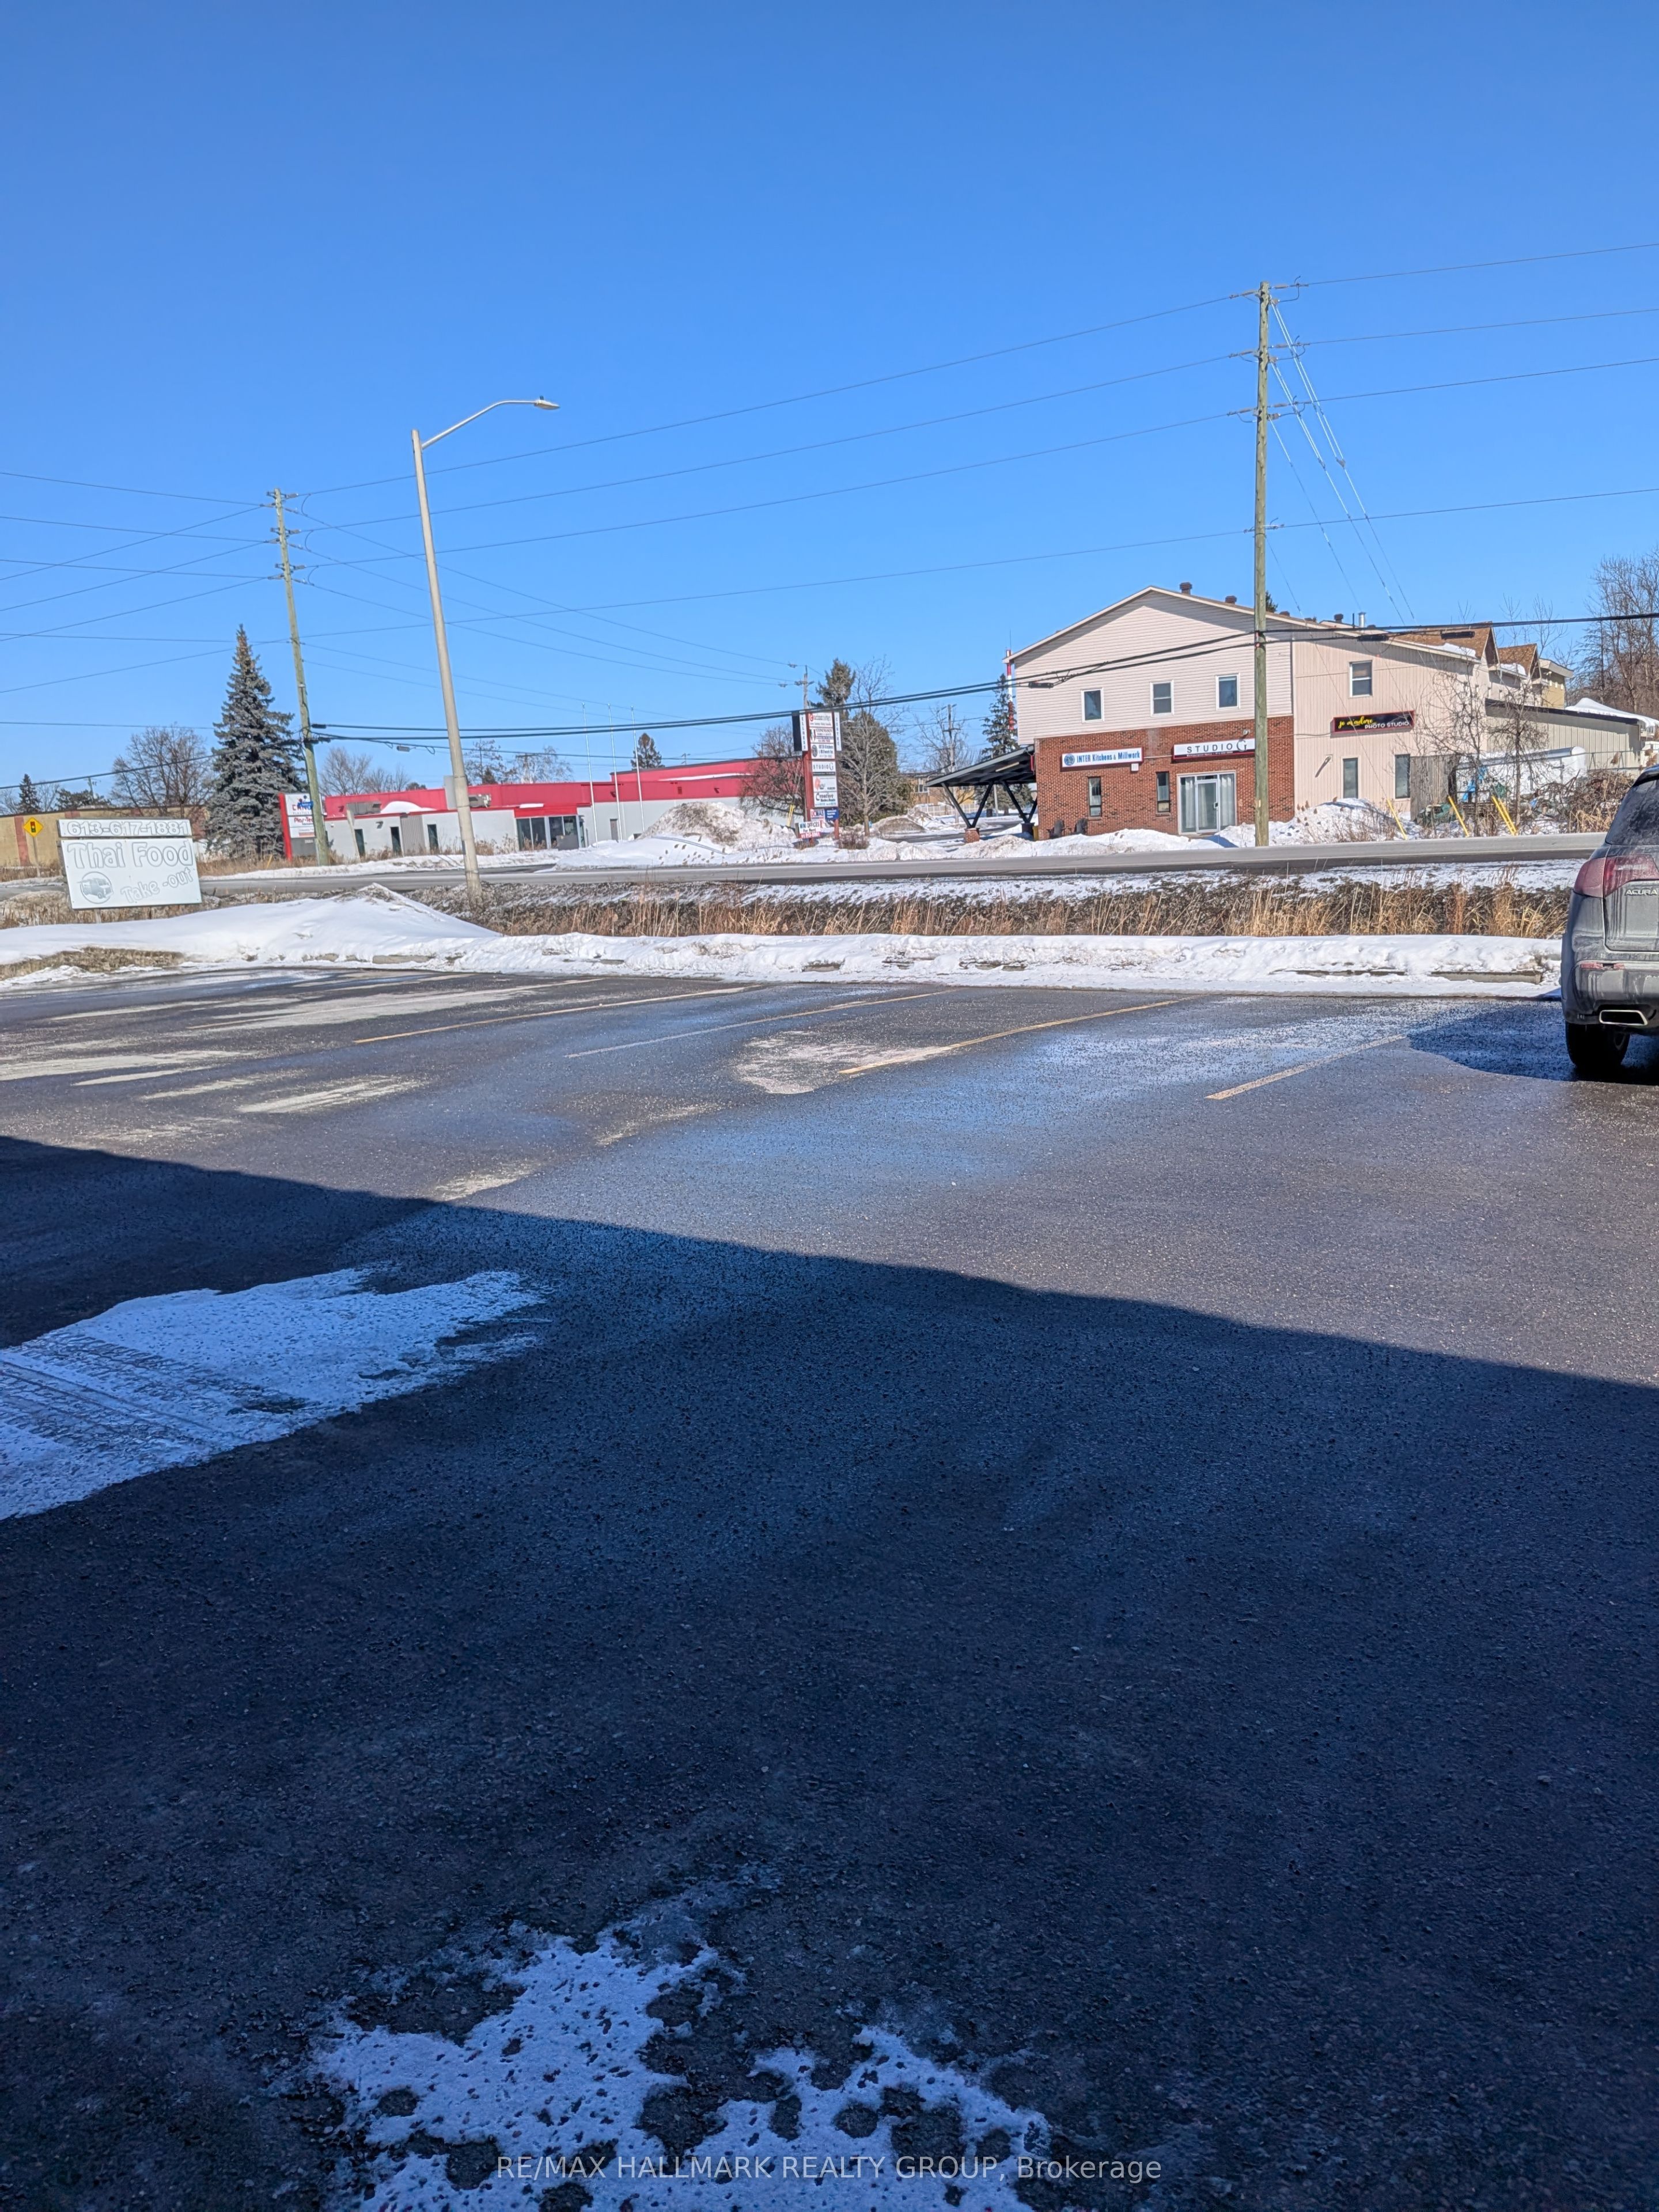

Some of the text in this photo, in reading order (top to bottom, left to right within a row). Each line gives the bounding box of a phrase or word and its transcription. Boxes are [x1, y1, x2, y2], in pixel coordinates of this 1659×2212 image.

[1077, 754, 1091, 763] INTER
[1092, 753, 1112, 762] Kitchens
[1118, 751, 1140, 760] Millwork
[67, 821, 190, 836] 613-617-1881
[67, 840, 194, 869] Thai Food
[120, 881, 161, 903] Take
